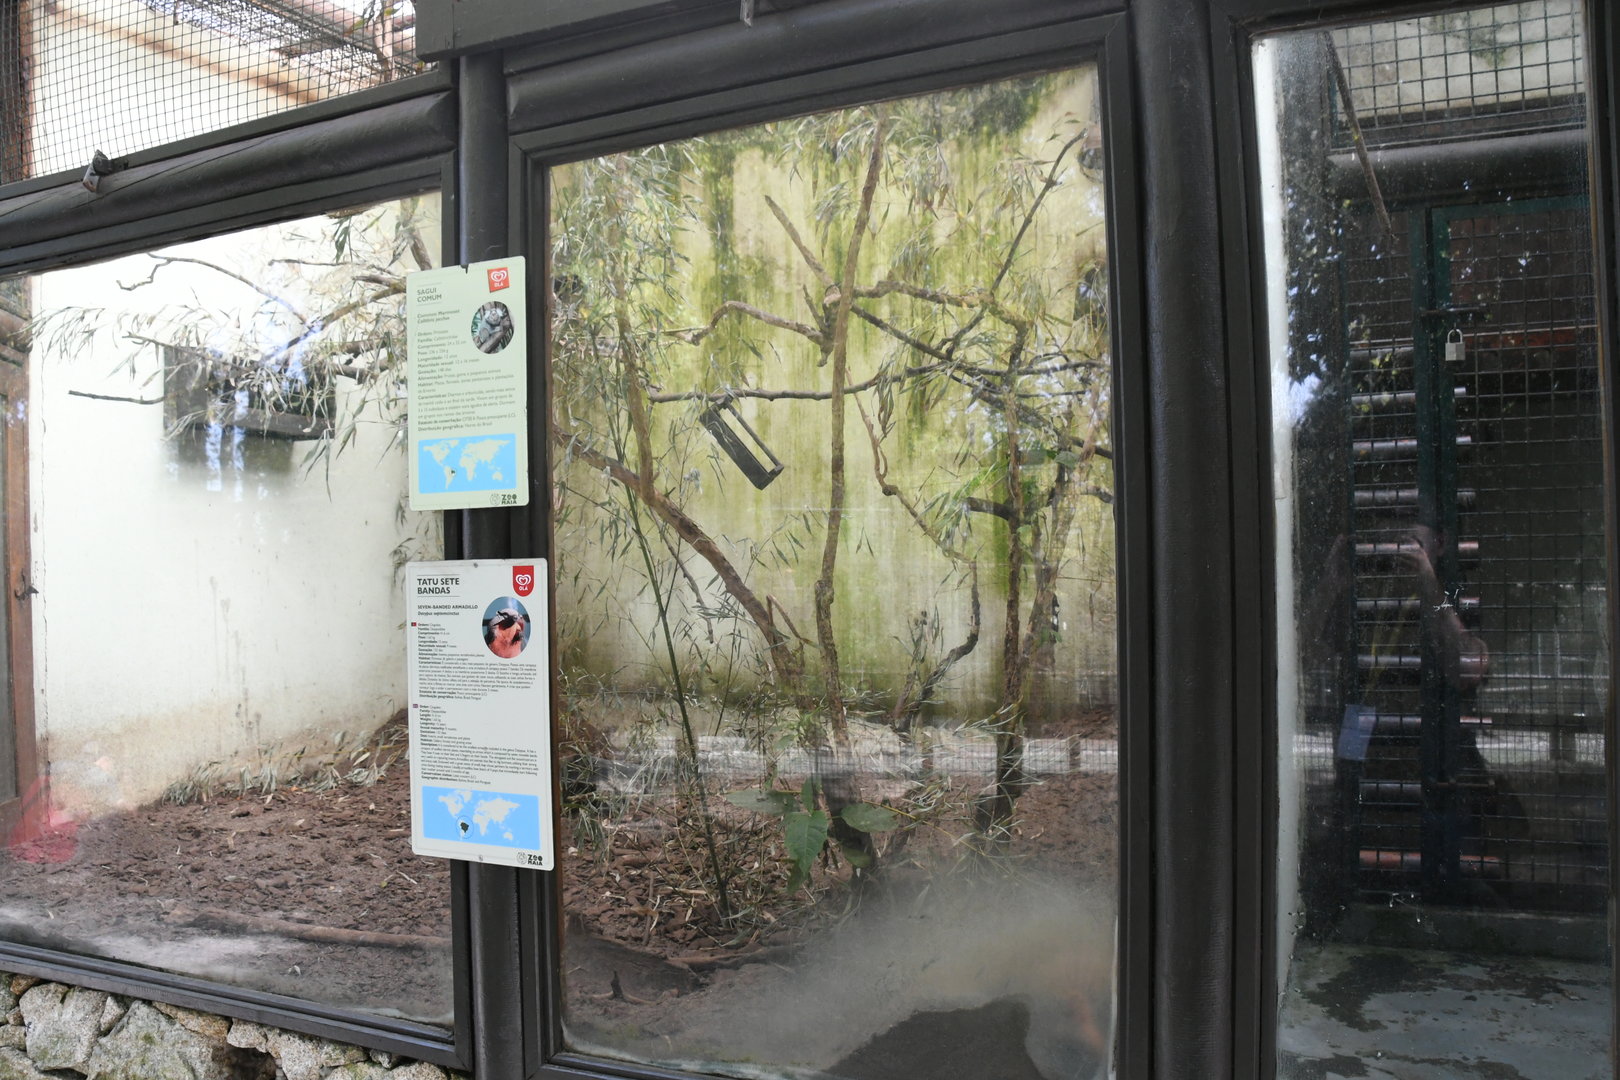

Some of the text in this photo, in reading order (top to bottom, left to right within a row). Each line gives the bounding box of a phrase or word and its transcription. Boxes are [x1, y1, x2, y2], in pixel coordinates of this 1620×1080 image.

[417, 287, 437, 296] SAGUI
[417, 294, 442, 303] COMUM
[417, 577, 460, 586] TATU SETE
[417, 586, 451, 595] BANDAS
[527, 854, 543, 862] ZOO
